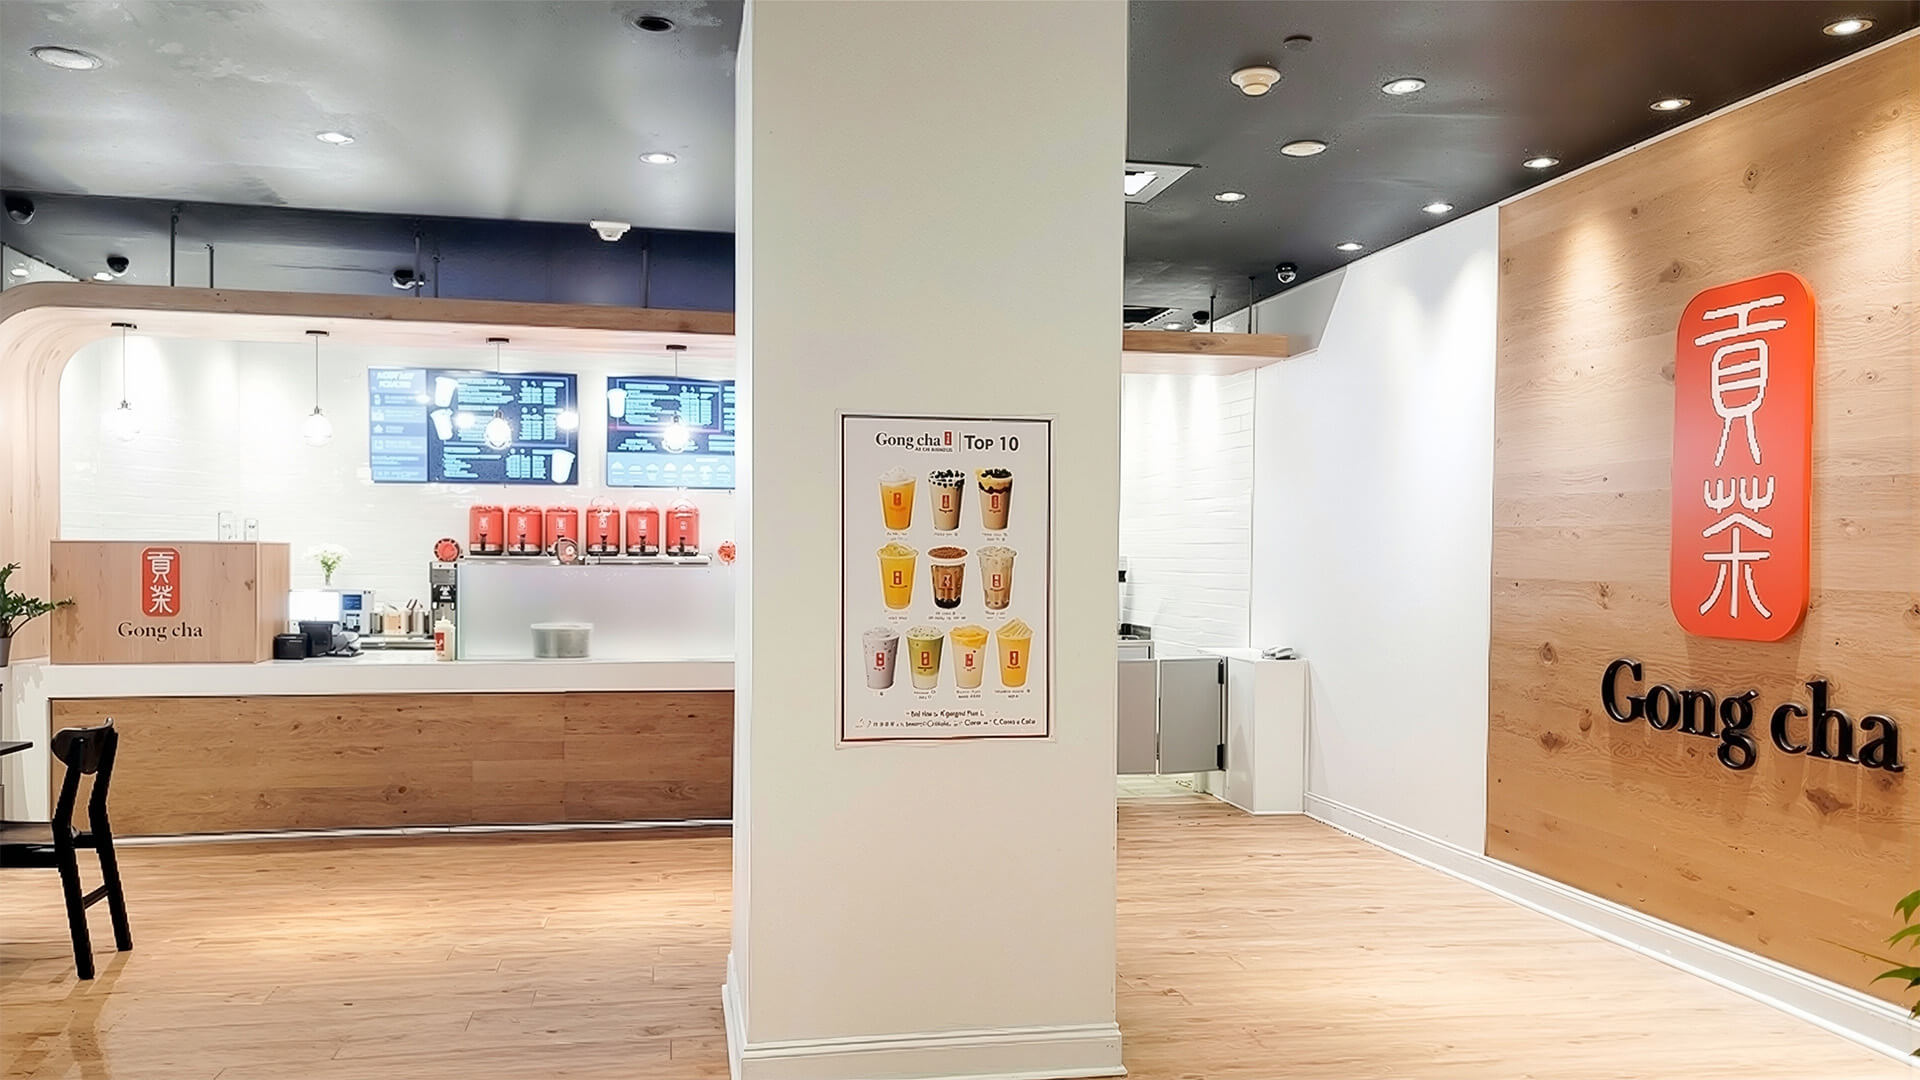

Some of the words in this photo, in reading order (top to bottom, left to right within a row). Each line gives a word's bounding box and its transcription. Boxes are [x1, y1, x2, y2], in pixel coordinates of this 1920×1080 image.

[875, 432, 914, 450] Gong
[916, 433, 941, 446] cha
[1000, 436, 1019, 451] 10
[1694, 295, 1788, 619] 貢茶
[147, 551, 175, 614] 貢茶
[117, 621, 168, 642] Gong
[172, 621, 203, 638] cha
[1601, 657, 1759, 771] Gong
[1770, 678, 1905, 773] cha
